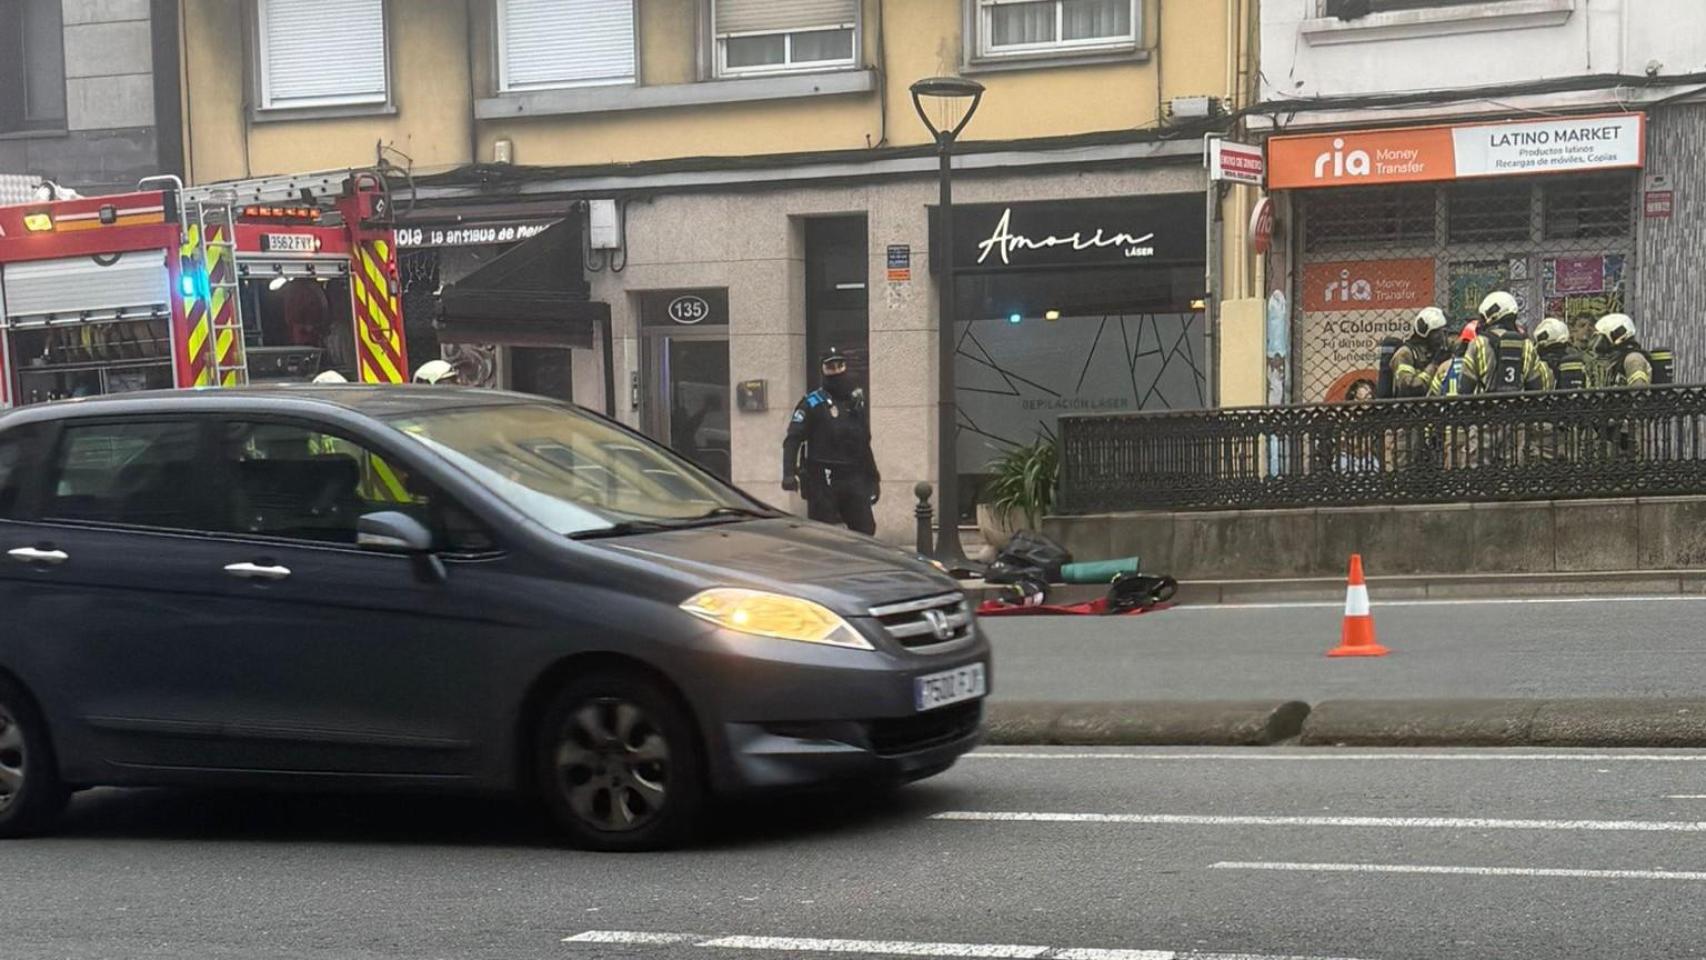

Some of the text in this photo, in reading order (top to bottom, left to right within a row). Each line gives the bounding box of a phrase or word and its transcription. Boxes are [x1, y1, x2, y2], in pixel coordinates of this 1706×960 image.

[1490, 126, 1622, 147] LATINO MARKET
[1314, 138, 1370, 178] ria
[1376, 149, 1418, 161] Money
[1519, 145, 1595, 157] Productos latinos
[1375, 161, 1424, 175] Transfer
[1496, 159, 1536, 168] Recargas
[1537, 157, 1548, 166] de
[498, 226, 515, 241] de
[1324, 268, 1372, 302] ria
[675, 301, 702, 318] 135
[1340, 318, 1411, 334] Colombia
[1504, 367, 1515, 383] 3
